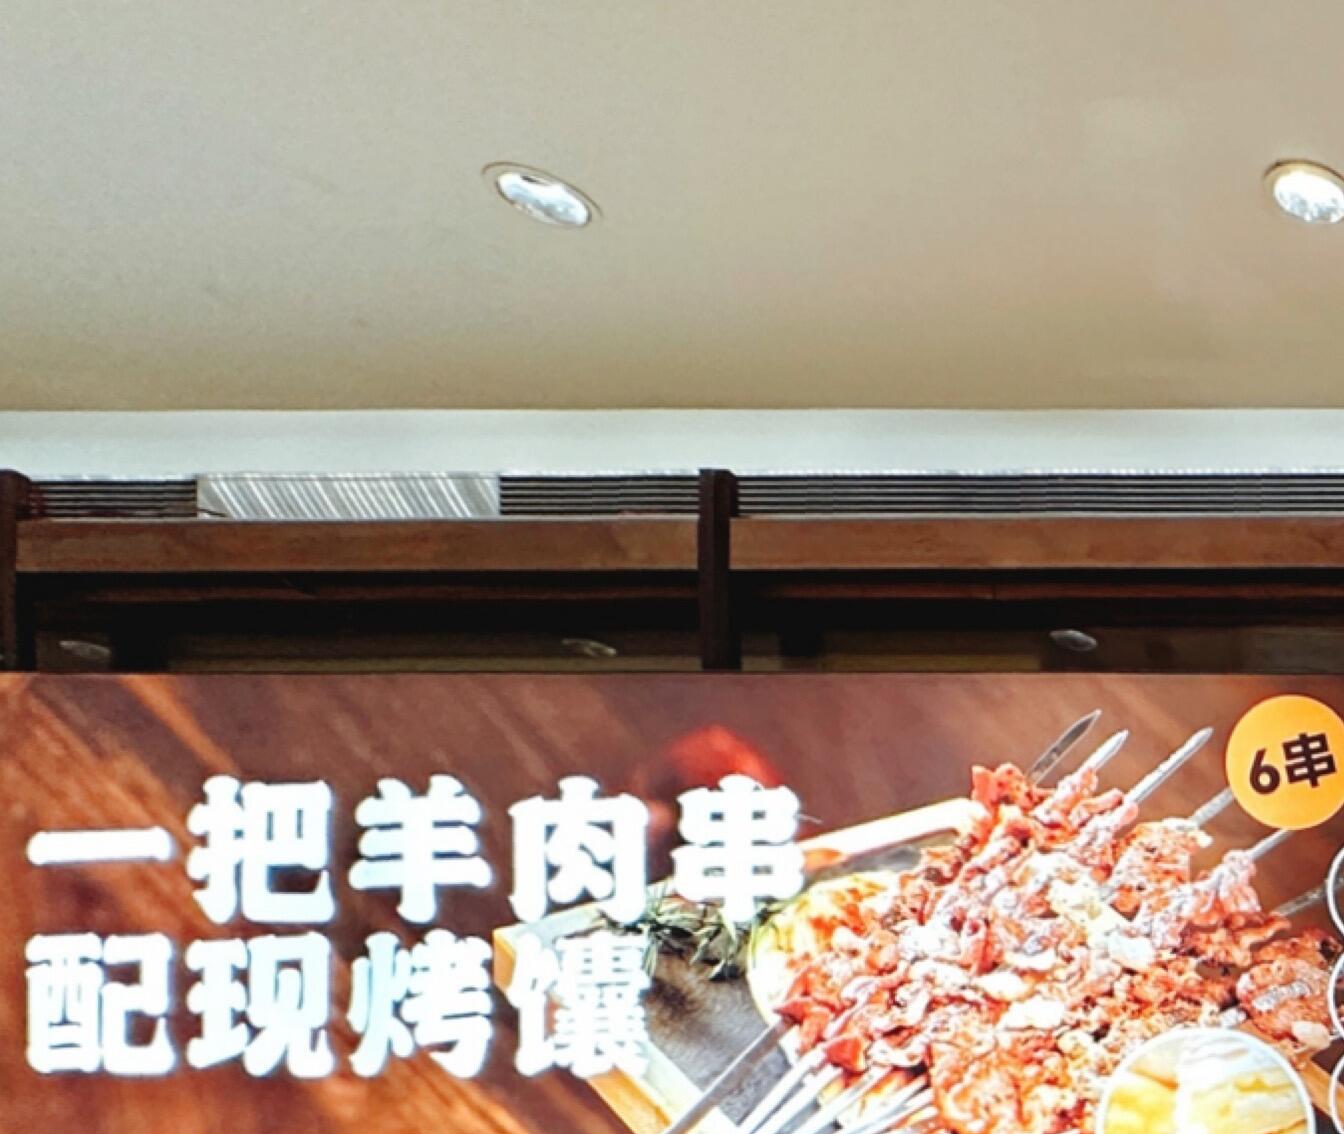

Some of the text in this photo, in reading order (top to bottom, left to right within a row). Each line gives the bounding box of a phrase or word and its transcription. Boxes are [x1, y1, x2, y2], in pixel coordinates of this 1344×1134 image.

[1248, 732, 1338, 794] 6串
[25, 774, 804, 924] 一把羊肉串
[25, 930, 652, 1079] 配现烤馕
